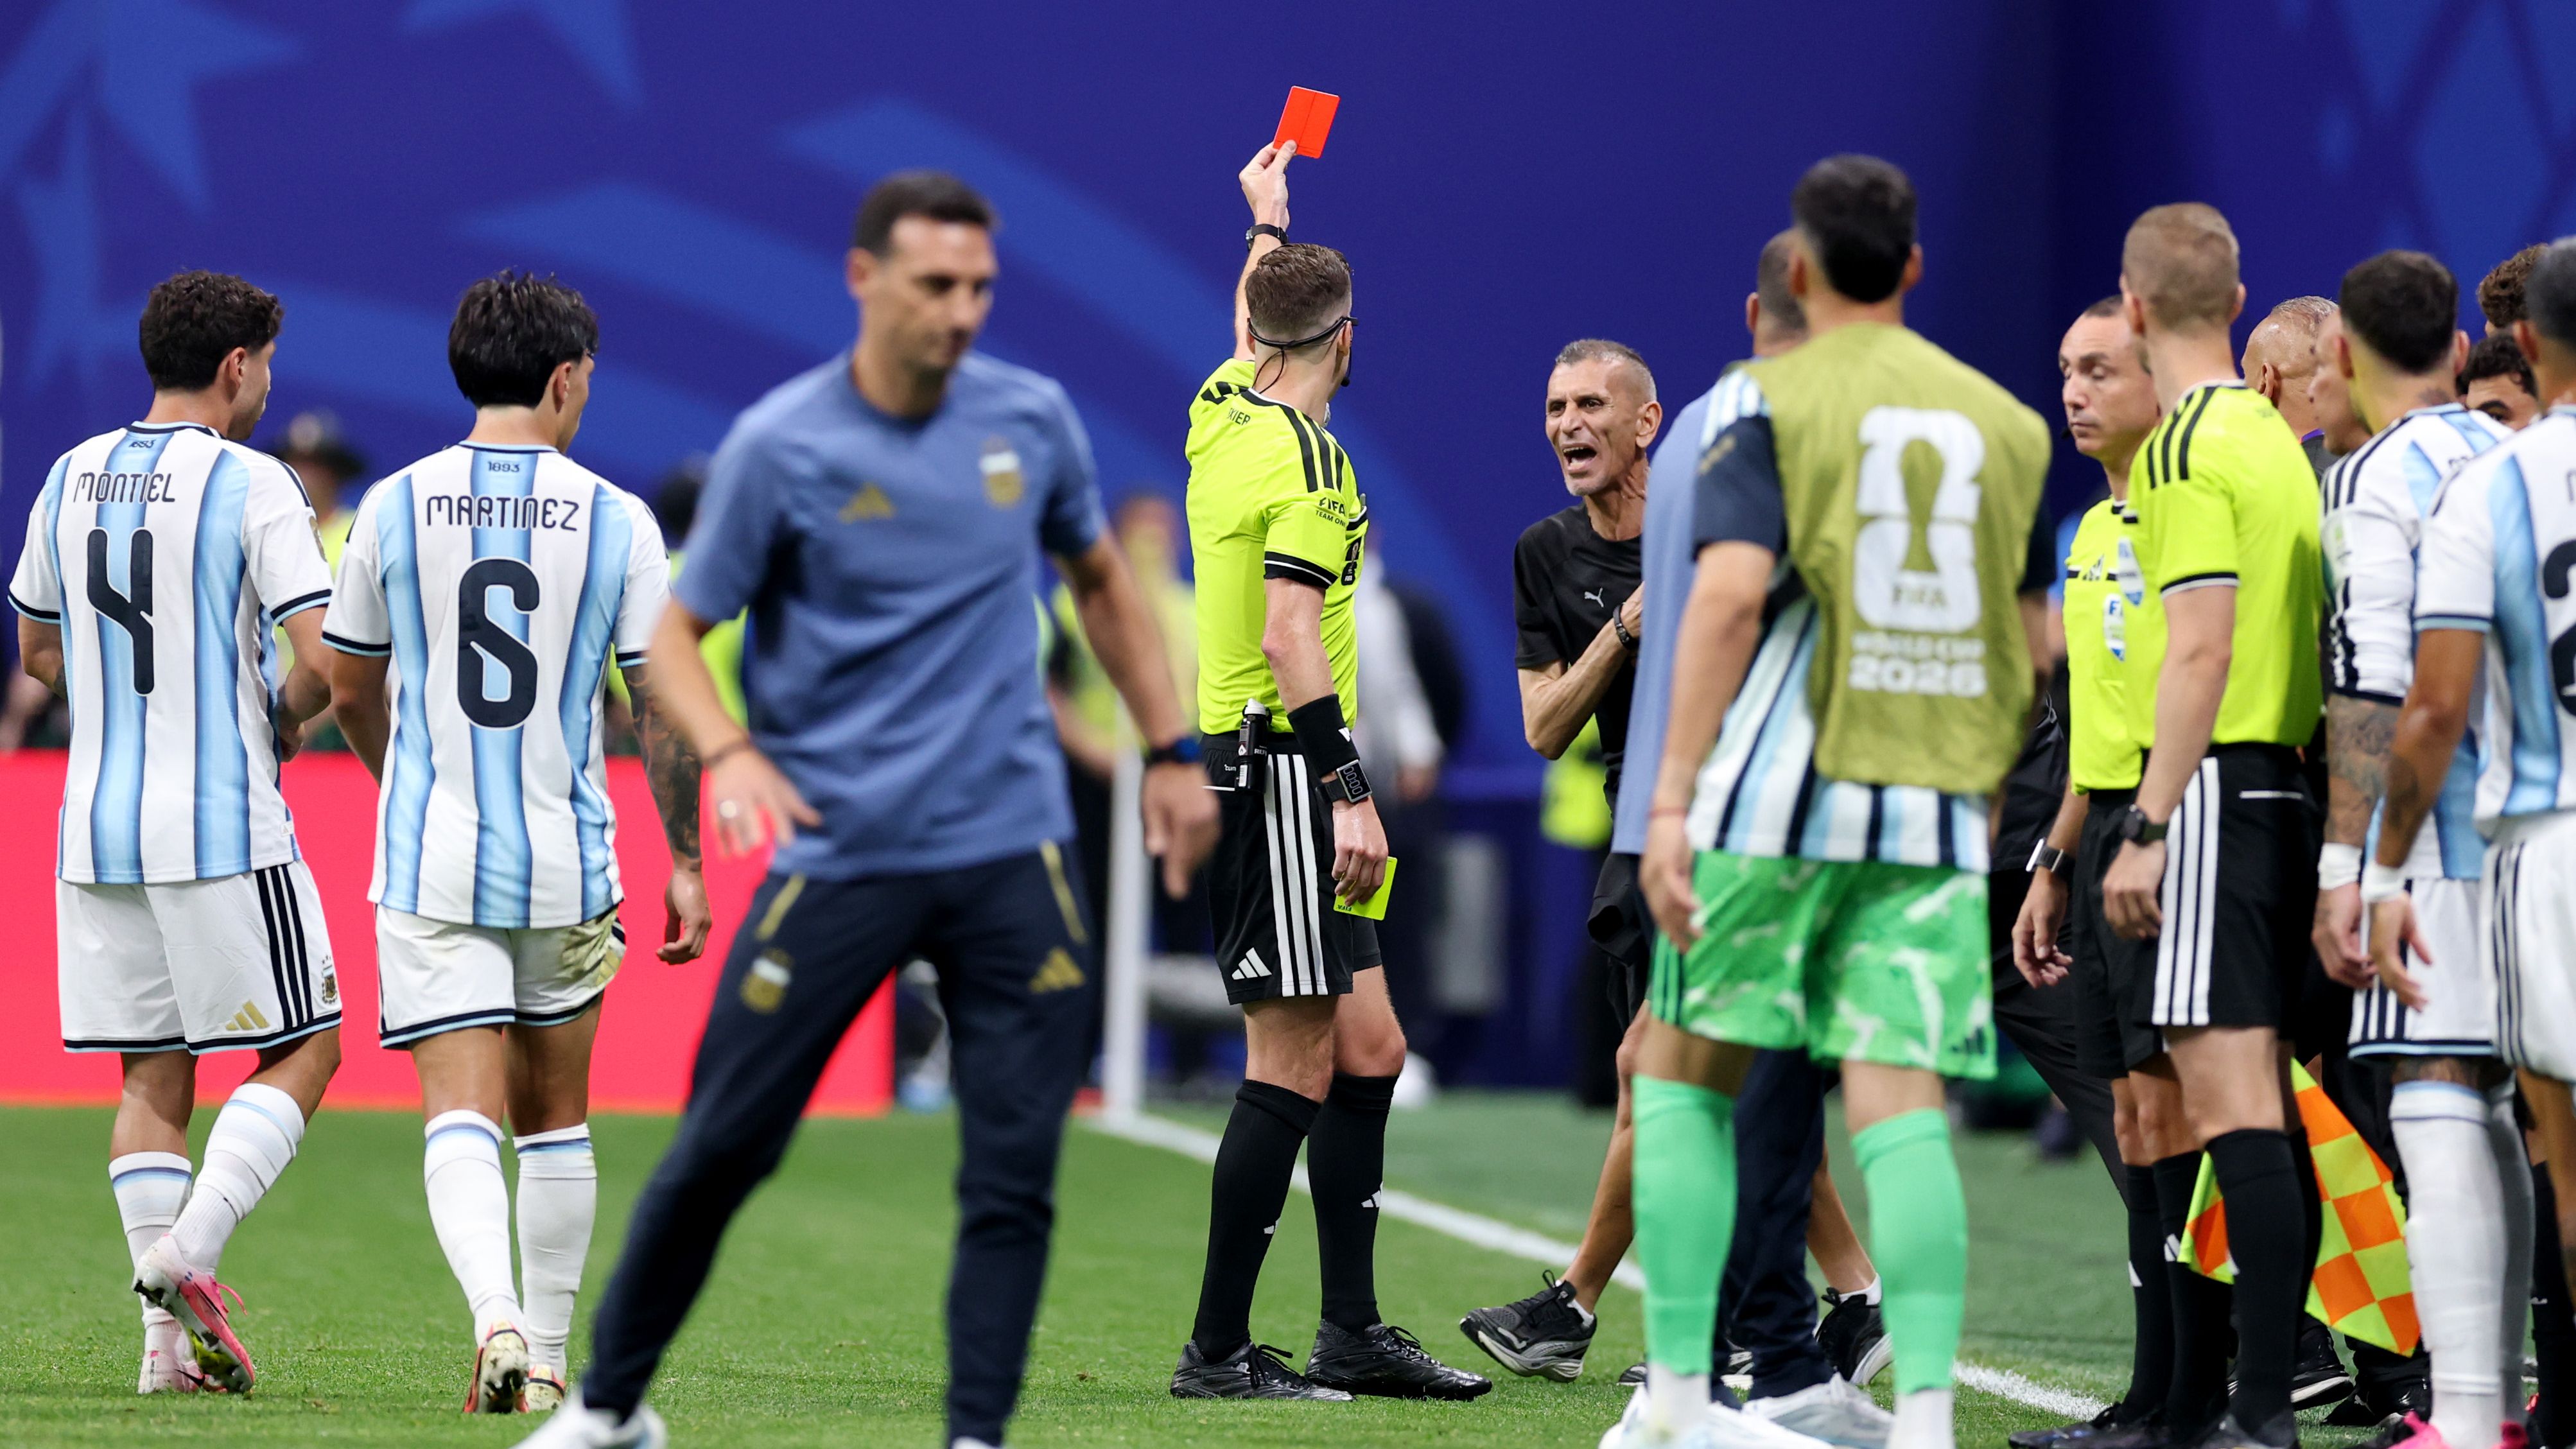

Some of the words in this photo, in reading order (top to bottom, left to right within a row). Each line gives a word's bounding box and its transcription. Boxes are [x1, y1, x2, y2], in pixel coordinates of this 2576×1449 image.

[487, 461, 520, 473] 1893
[73, 472, 175, 503] MONTIEL
[427, 495, 579, 532] MARTINEZ
[1316, 510, 1334, 522] TEAM
[1319, 497, 1346, 516] FIFA
[87, 528, 154, 695] 4
[458, 558, 540, 729] 6
[1848, 653, 1987, 698] 2026
